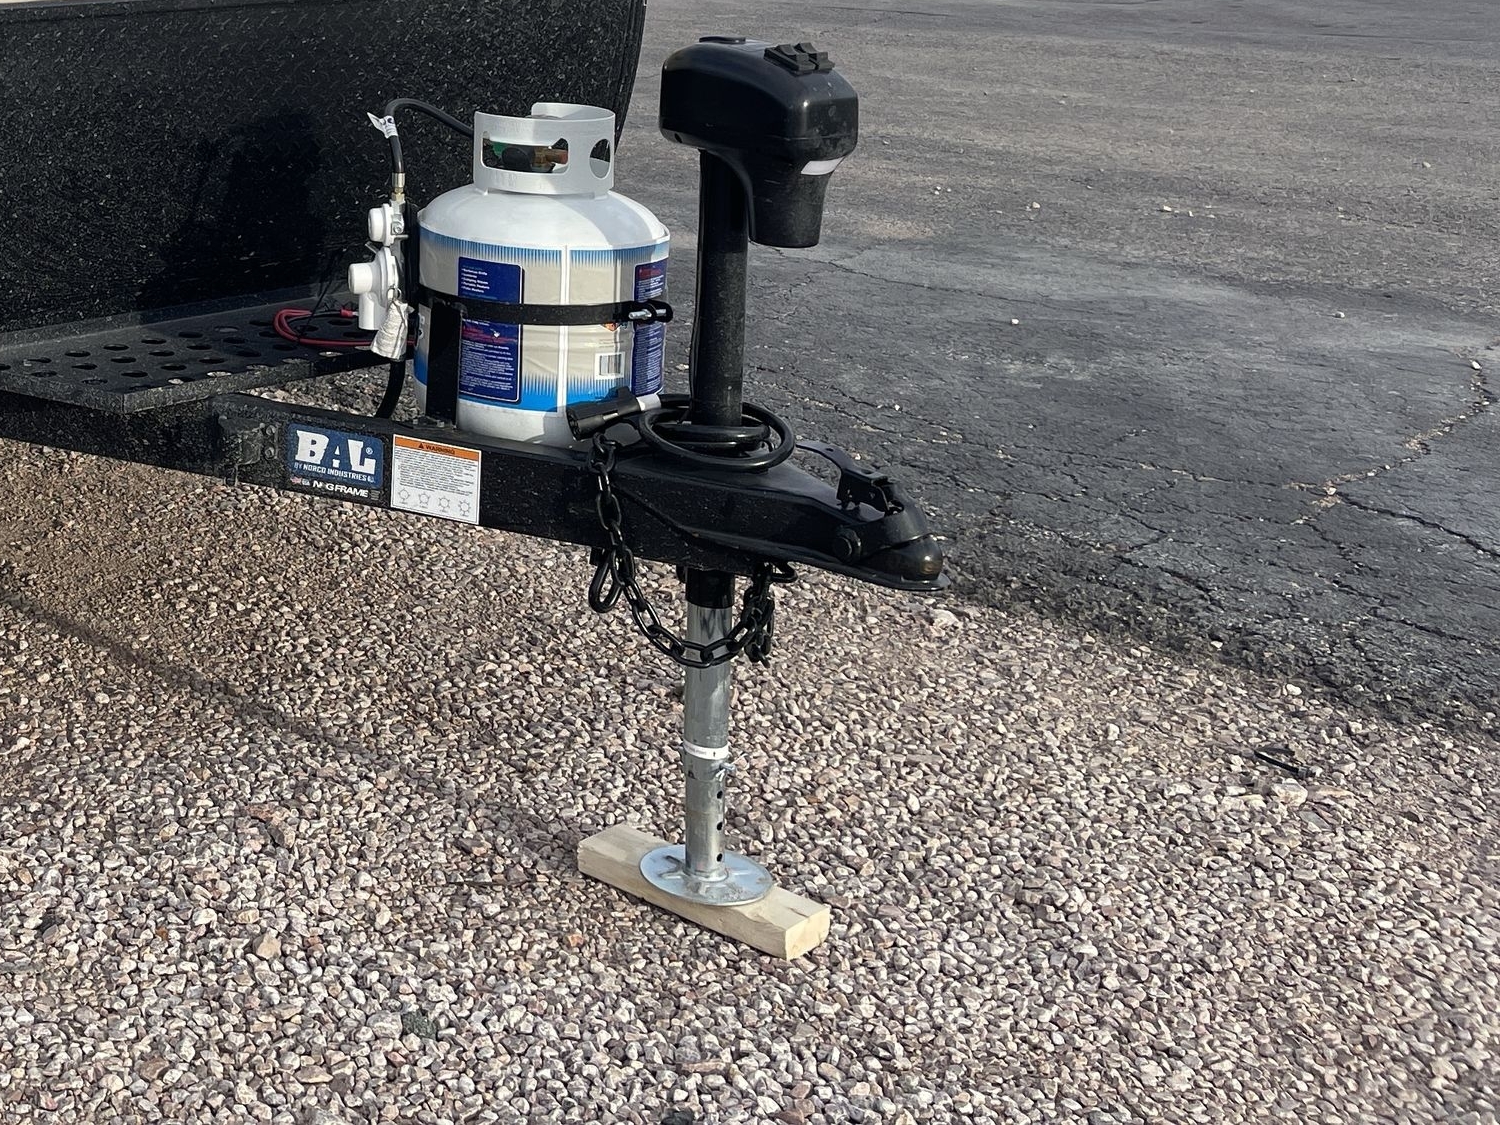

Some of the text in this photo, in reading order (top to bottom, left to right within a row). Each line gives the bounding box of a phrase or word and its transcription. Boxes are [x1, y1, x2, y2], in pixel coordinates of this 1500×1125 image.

[425, 444, 456, 455] WARNING
[303, 462, 327, 474] NORCO
[327, 468, 367, 481] INDUSTRIES
[335, 484, 369, 498] FRAME
